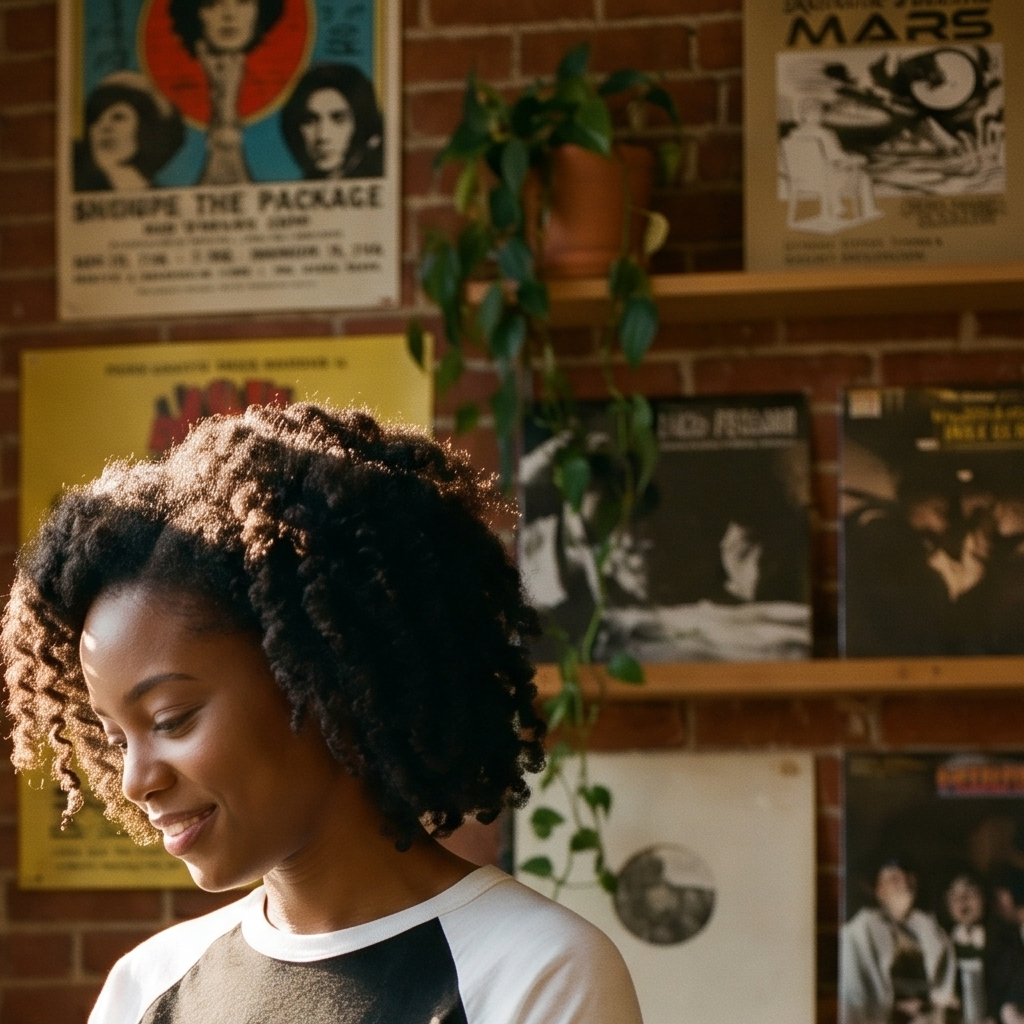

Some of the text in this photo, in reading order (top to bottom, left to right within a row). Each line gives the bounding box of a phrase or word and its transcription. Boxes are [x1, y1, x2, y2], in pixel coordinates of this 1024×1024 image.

[787, 8, 994, 46] MARS
[196, 191, 243, 214] THE
[259, 185, 380, 211] PACKAGE
